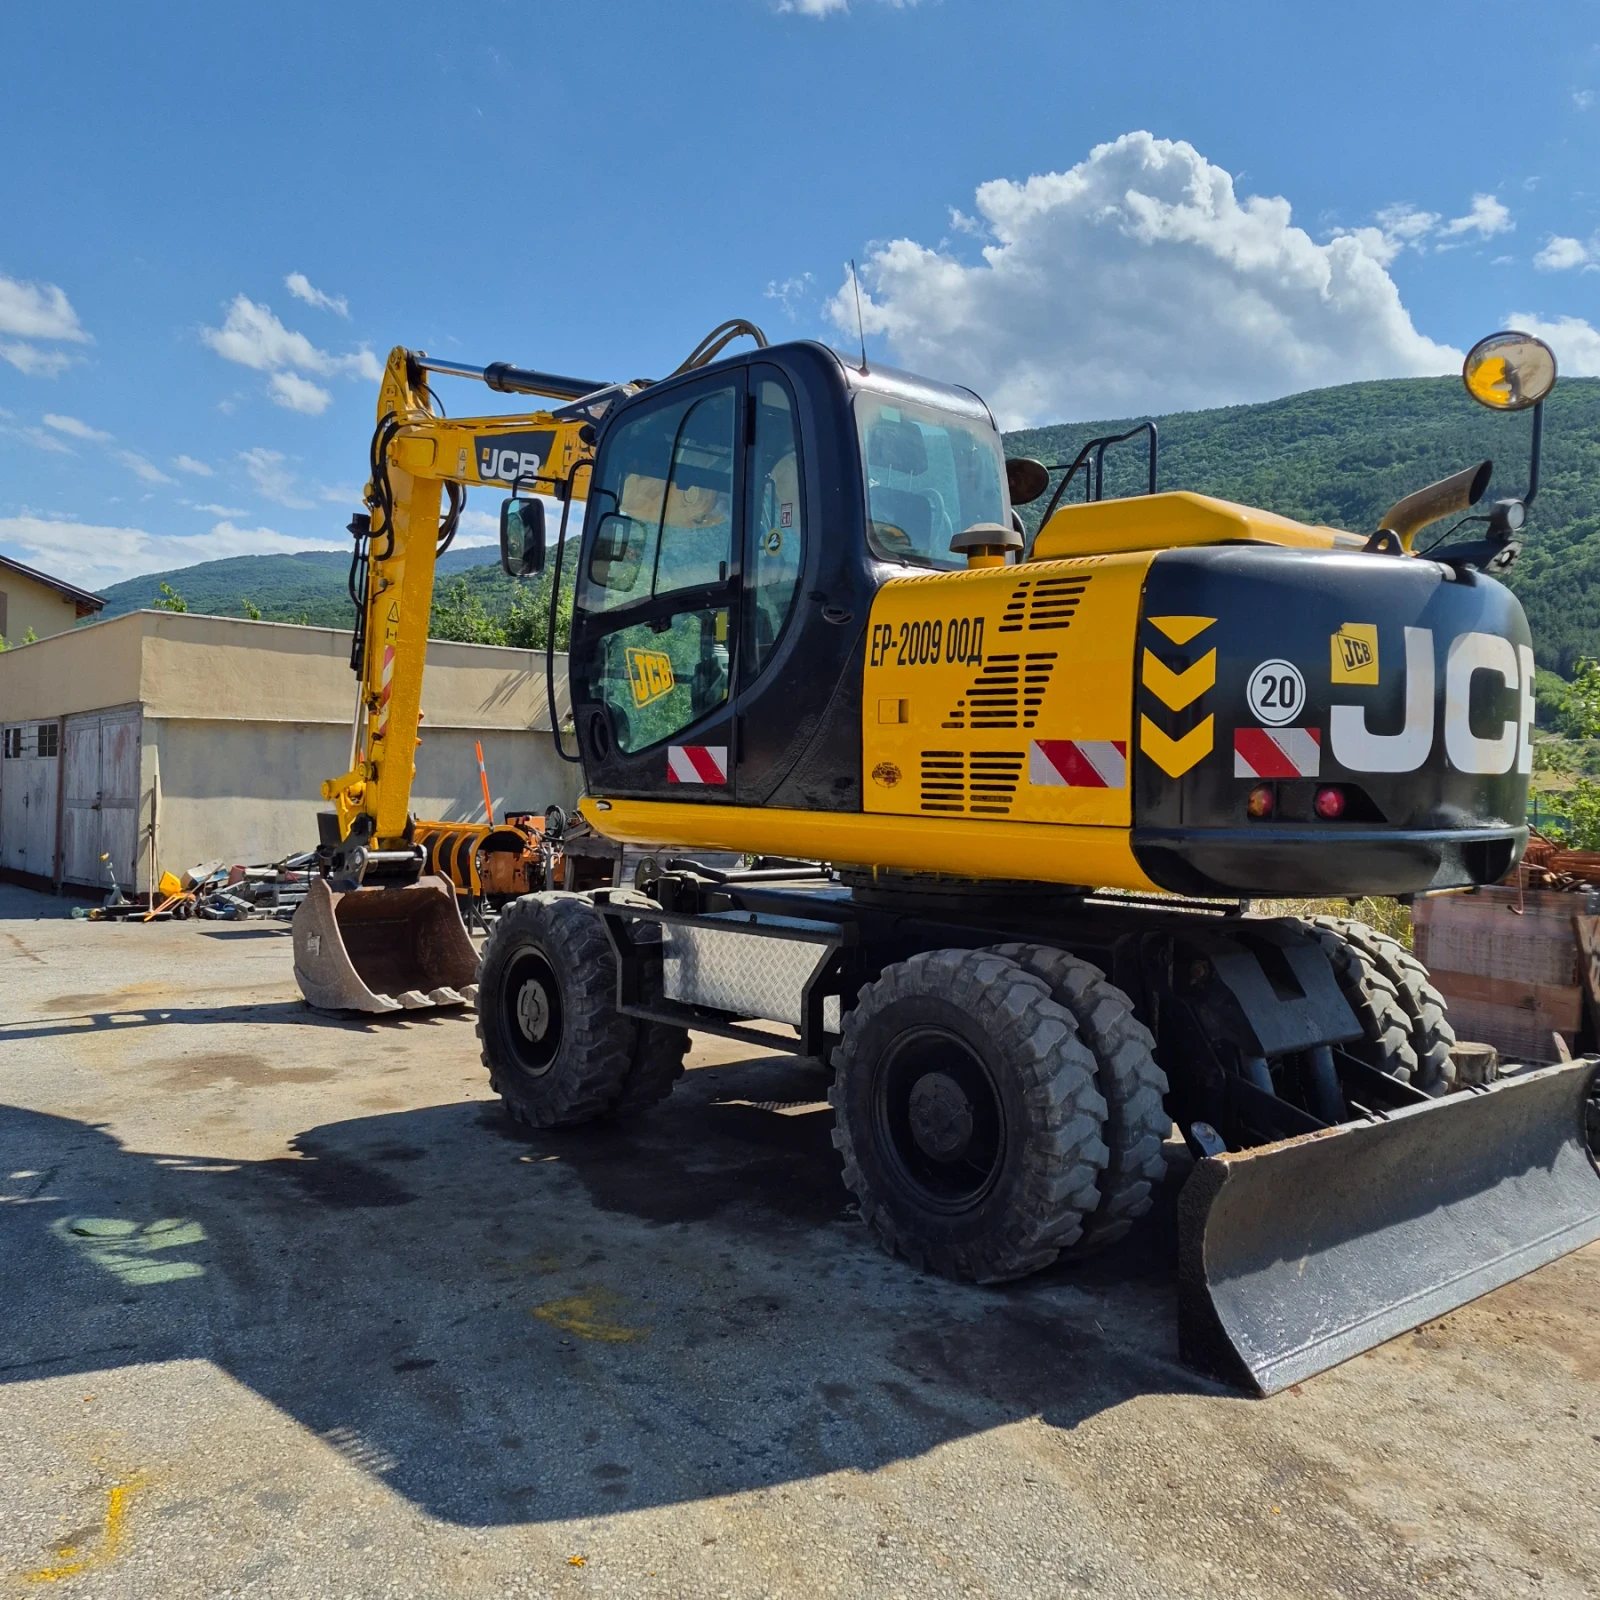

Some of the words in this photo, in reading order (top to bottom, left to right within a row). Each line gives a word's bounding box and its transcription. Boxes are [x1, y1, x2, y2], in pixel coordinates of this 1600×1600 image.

[481, 449, 540, 483] JCB
[1343, 638, 1371, 667] JCB
[634, 654, 671, 700] JCB
[1260, 675, 1295, 708] 20
